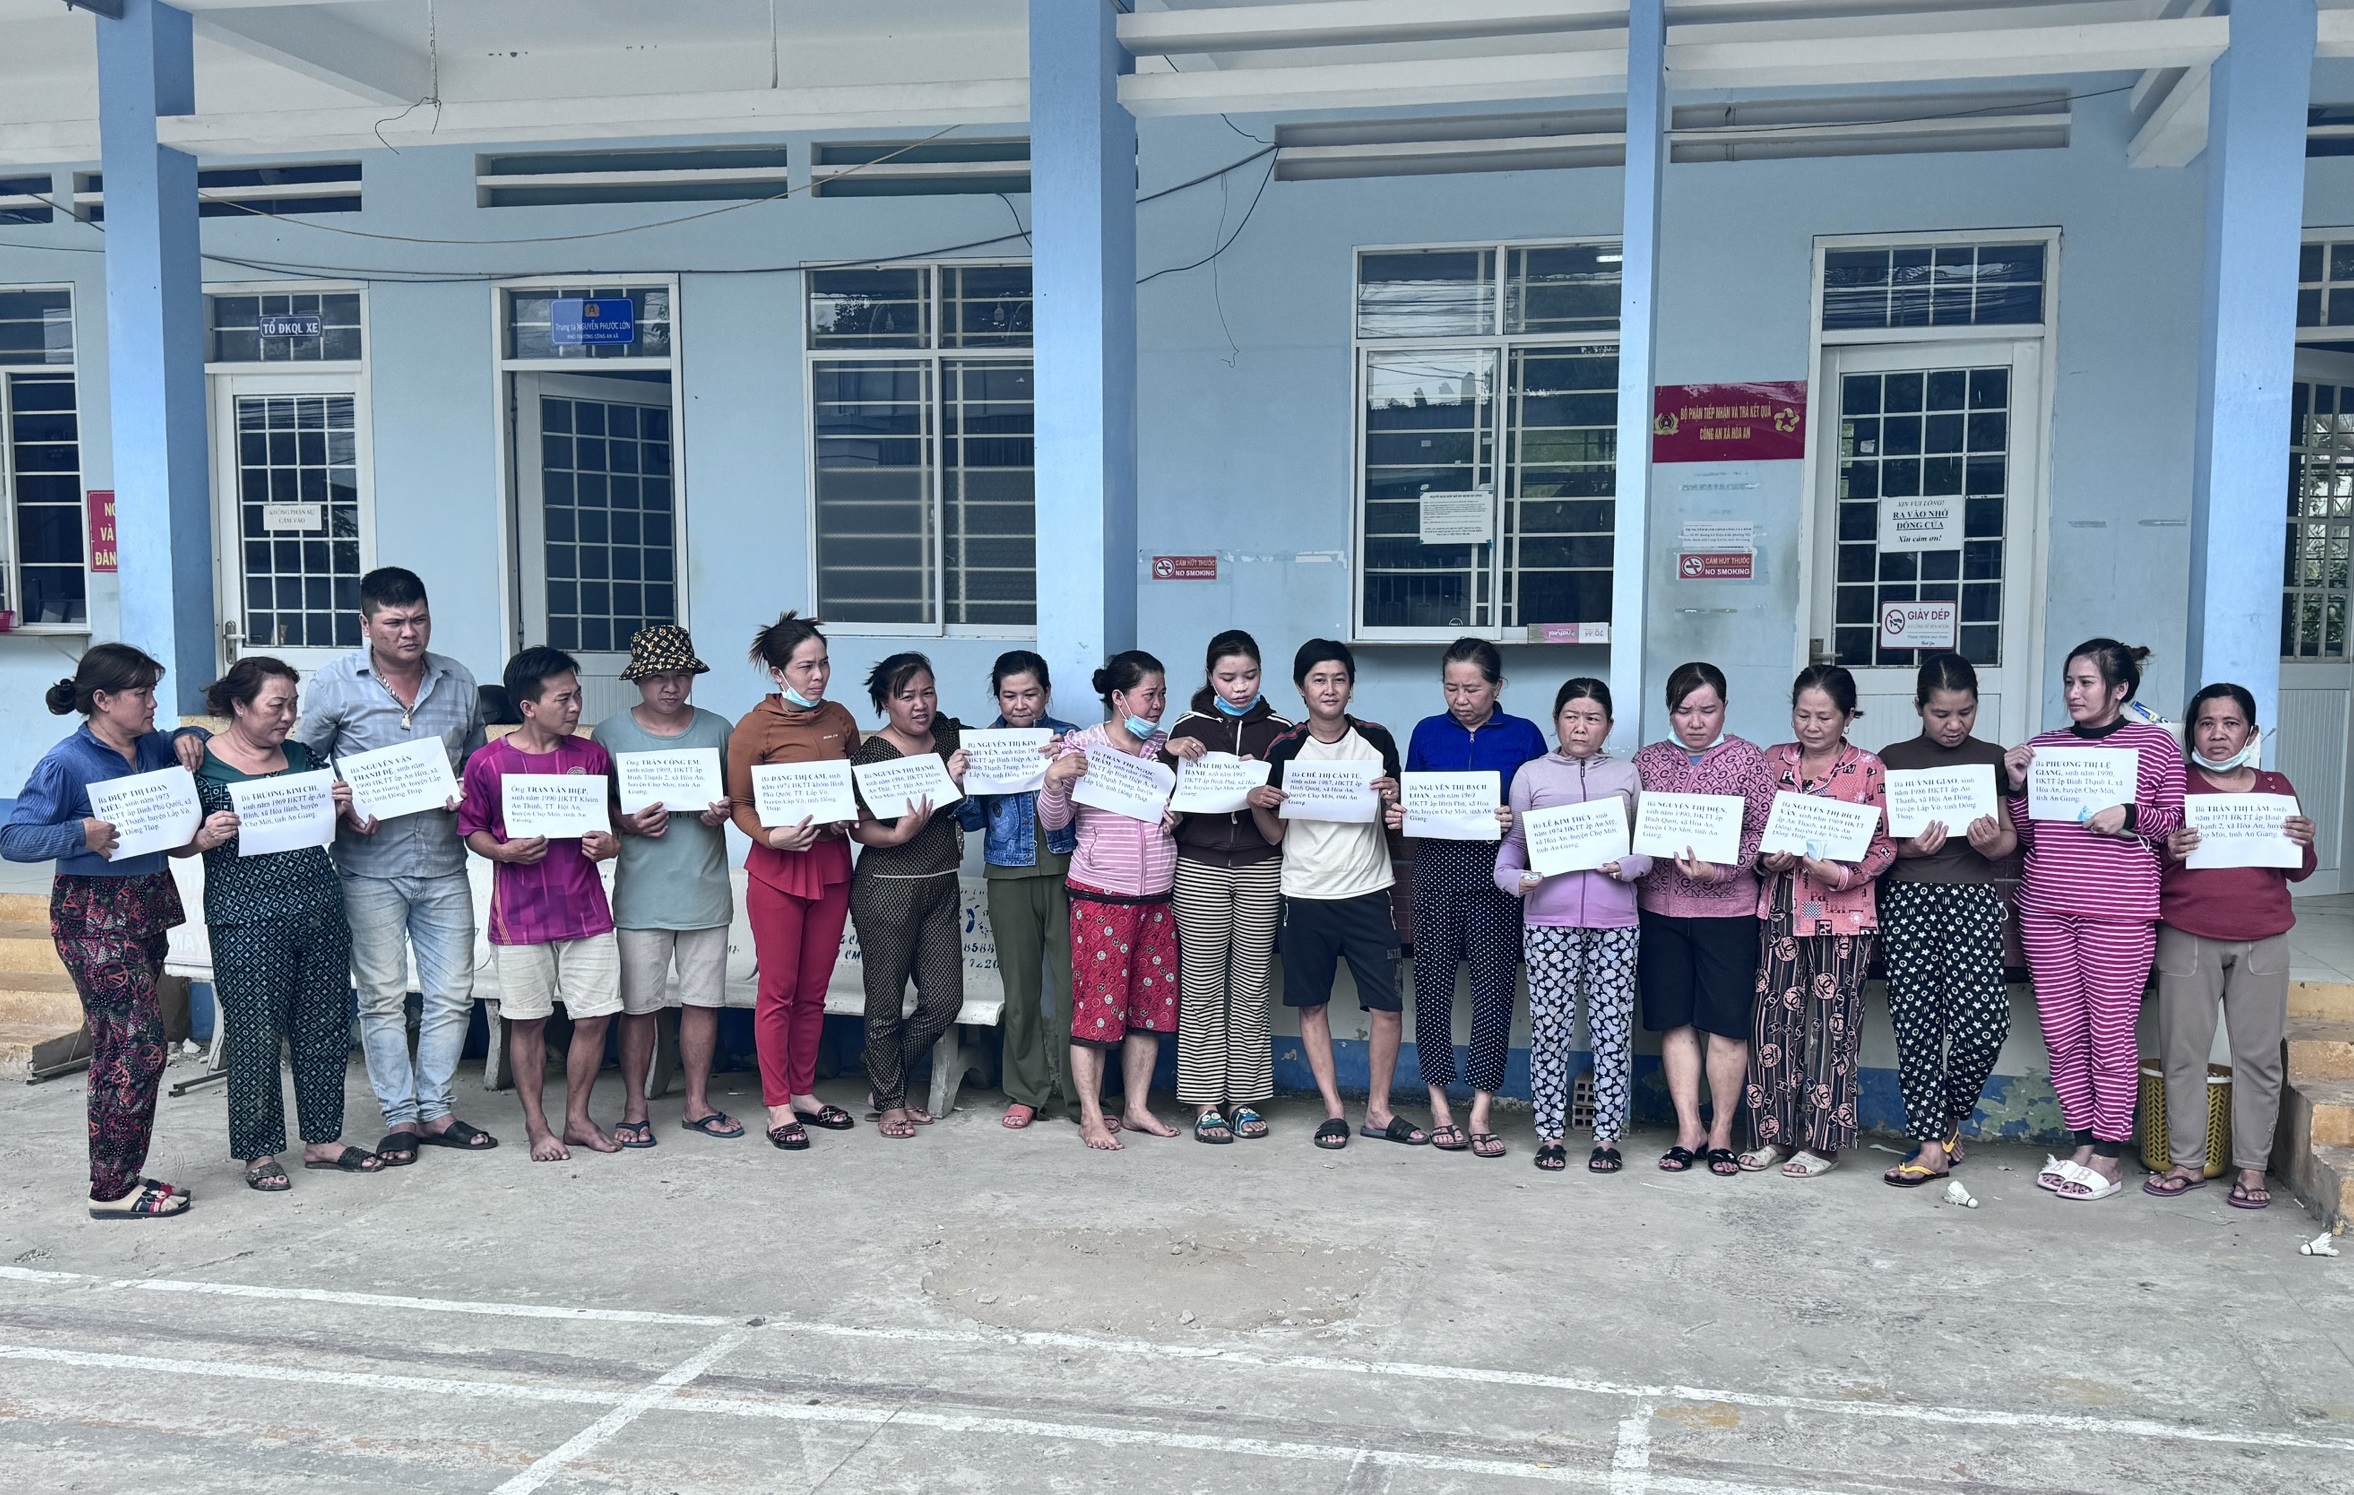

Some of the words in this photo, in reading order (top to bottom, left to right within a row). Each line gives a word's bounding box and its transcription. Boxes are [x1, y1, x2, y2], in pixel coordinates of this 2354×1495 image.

[263, 318, 276, 334] TỔ
[278, 323, 303, 335] ĐKQL
[306, 323, 318, 333] XE
[1715, 427, 1722, 439] AN
[1743, 426, 1750, 439] AN
[1908, 510, 1926, 518] VÀO
[100, 523, 114, 541] VÀ
[95, 549, 117, 566] ĐĂN
[1706, 556, 1718, 565] CẤM
[1719, 556, 1730, 564] HÚT
[1732, 556, 1750, 564] THUỐC
[1907, 608, 1929, 620] GIÀY
[1932, 608, 1950, 620] DÉP
